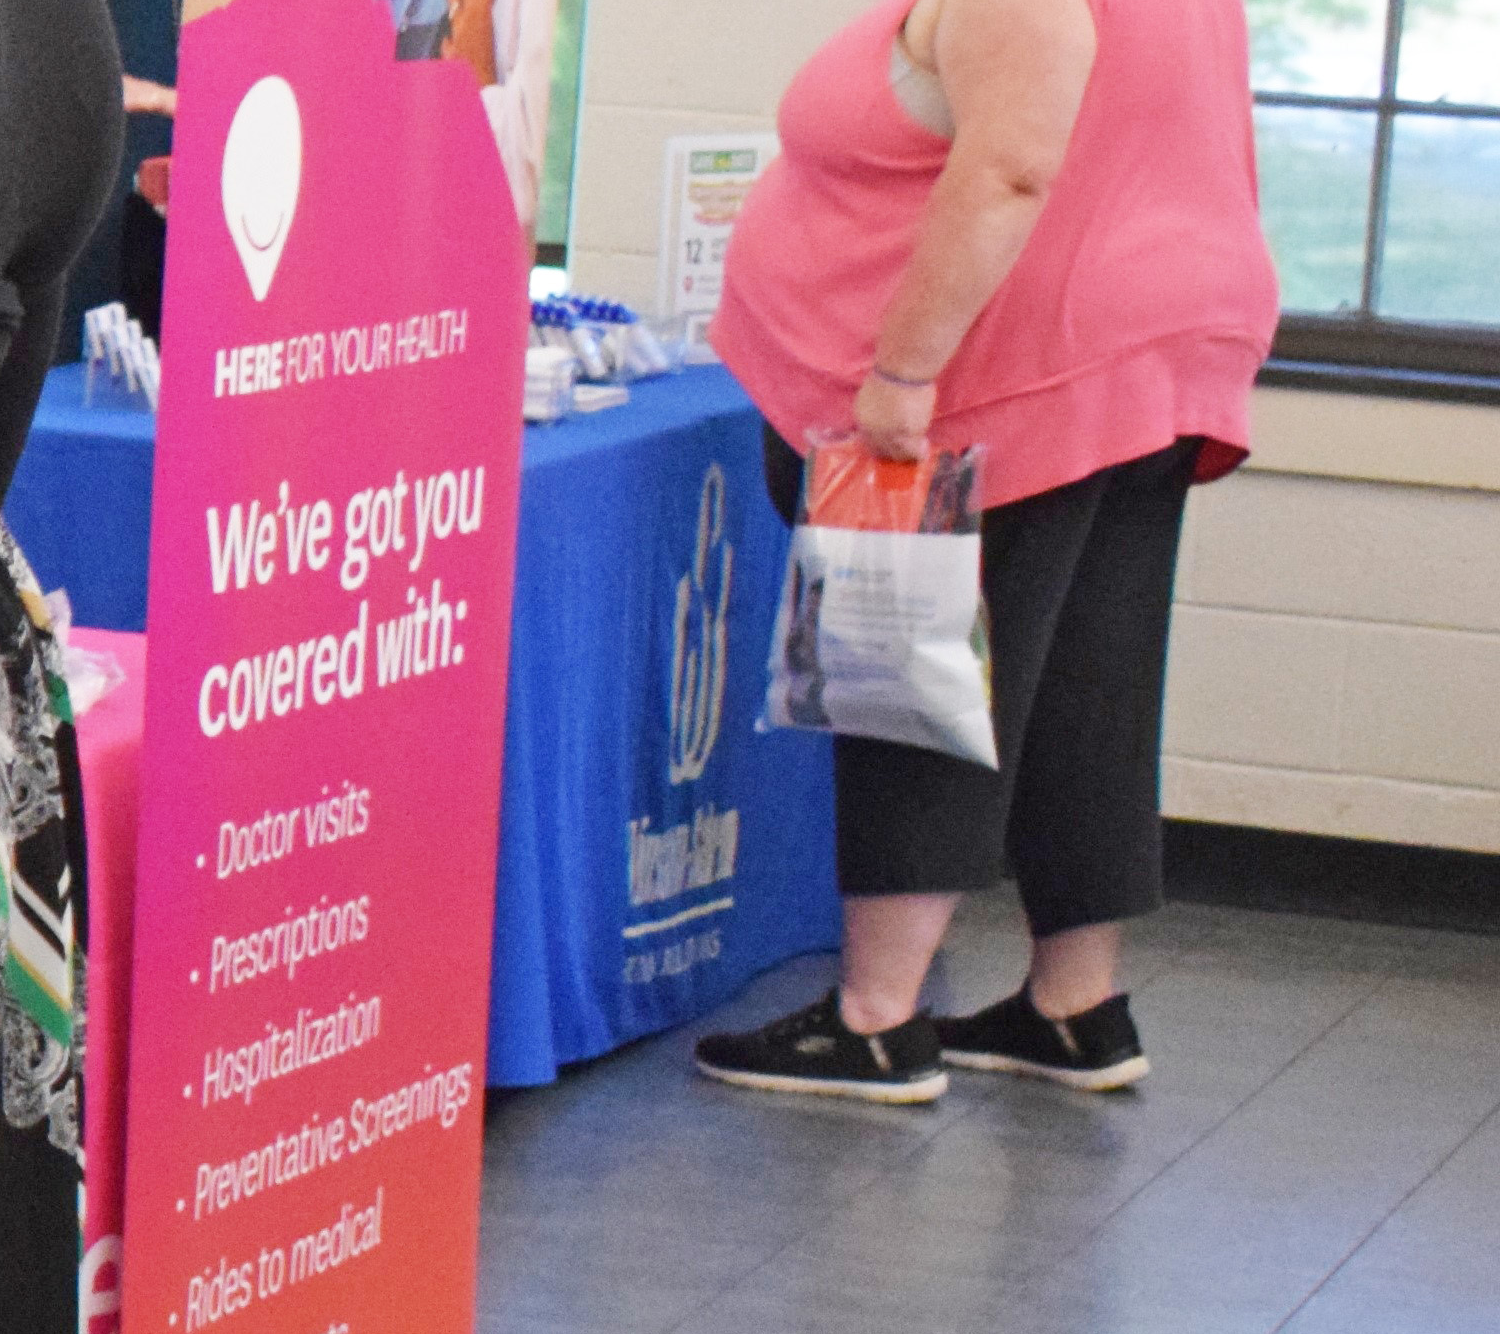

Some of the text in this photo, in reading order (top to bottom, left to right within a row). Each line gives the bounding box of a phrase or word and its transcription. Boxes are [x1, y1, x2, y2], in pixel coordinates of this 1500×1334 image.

[214, 309, 468, 398] HERE FOR YOUR HEALTH
[206, 465, 485, 595] We've got you
[198, 579, 468, 739] covered with:
[216, 780, 370, 880] Doctor visits
[209, 893, 371, 994] Prescriptions
[201, 993, 383, 1109] Hospitalization
[194, 1060, 474, 1222] Preventative Screenings
[259, 1242, 286, 1301] to
[290, 1187, 385, 1281] medical
